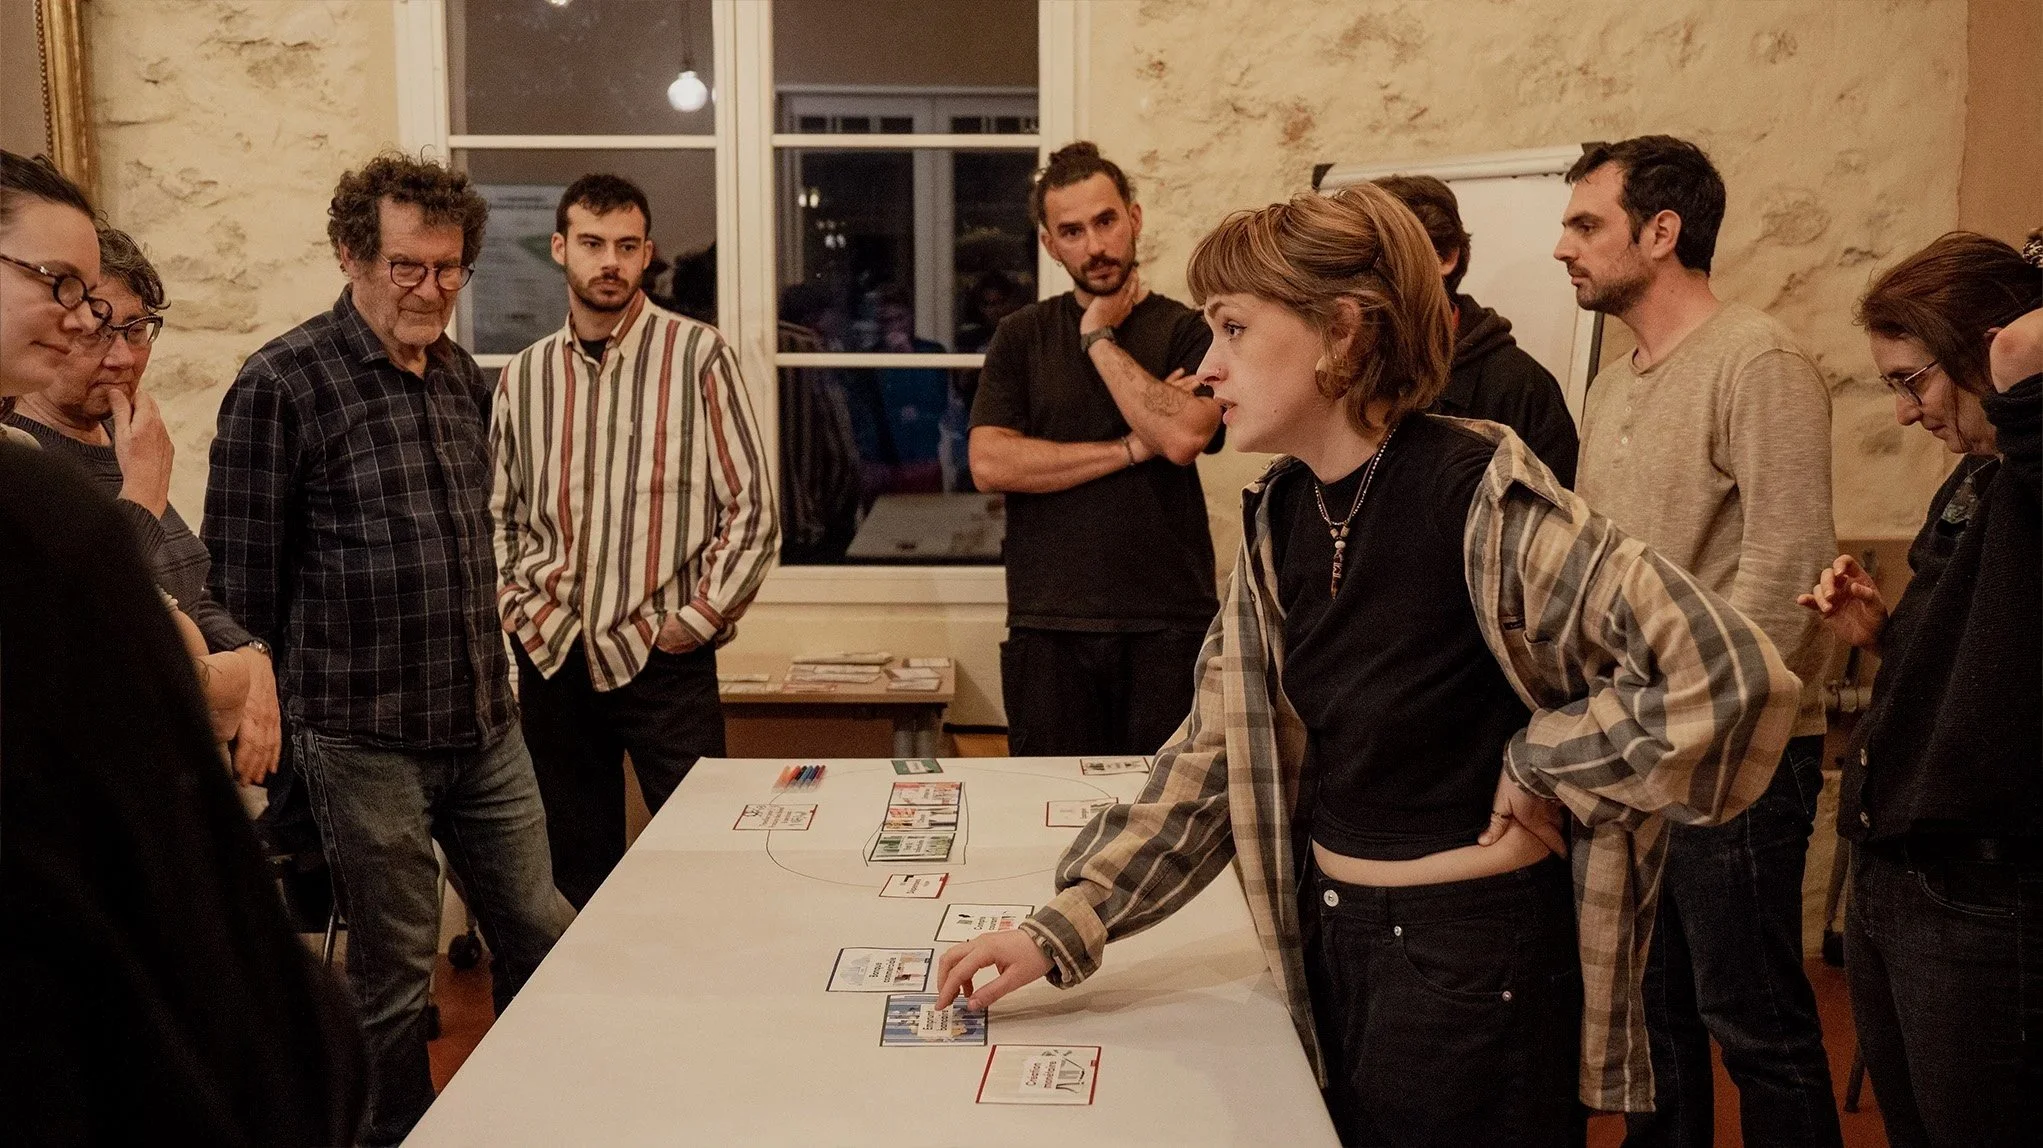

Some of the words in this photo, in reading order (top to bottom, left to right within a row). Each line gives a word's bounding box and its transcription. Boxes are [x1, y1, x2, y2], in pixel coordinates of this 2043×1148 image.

[883, 957, 896, 983] commerciale
[922, 1010, 936, 1030] Emprunt
[937, 1010, 949, 1031] bancaire
[1025, 1062, 1041, 1086] Création
[1043, 1061, 1057, 1089] monétaire
